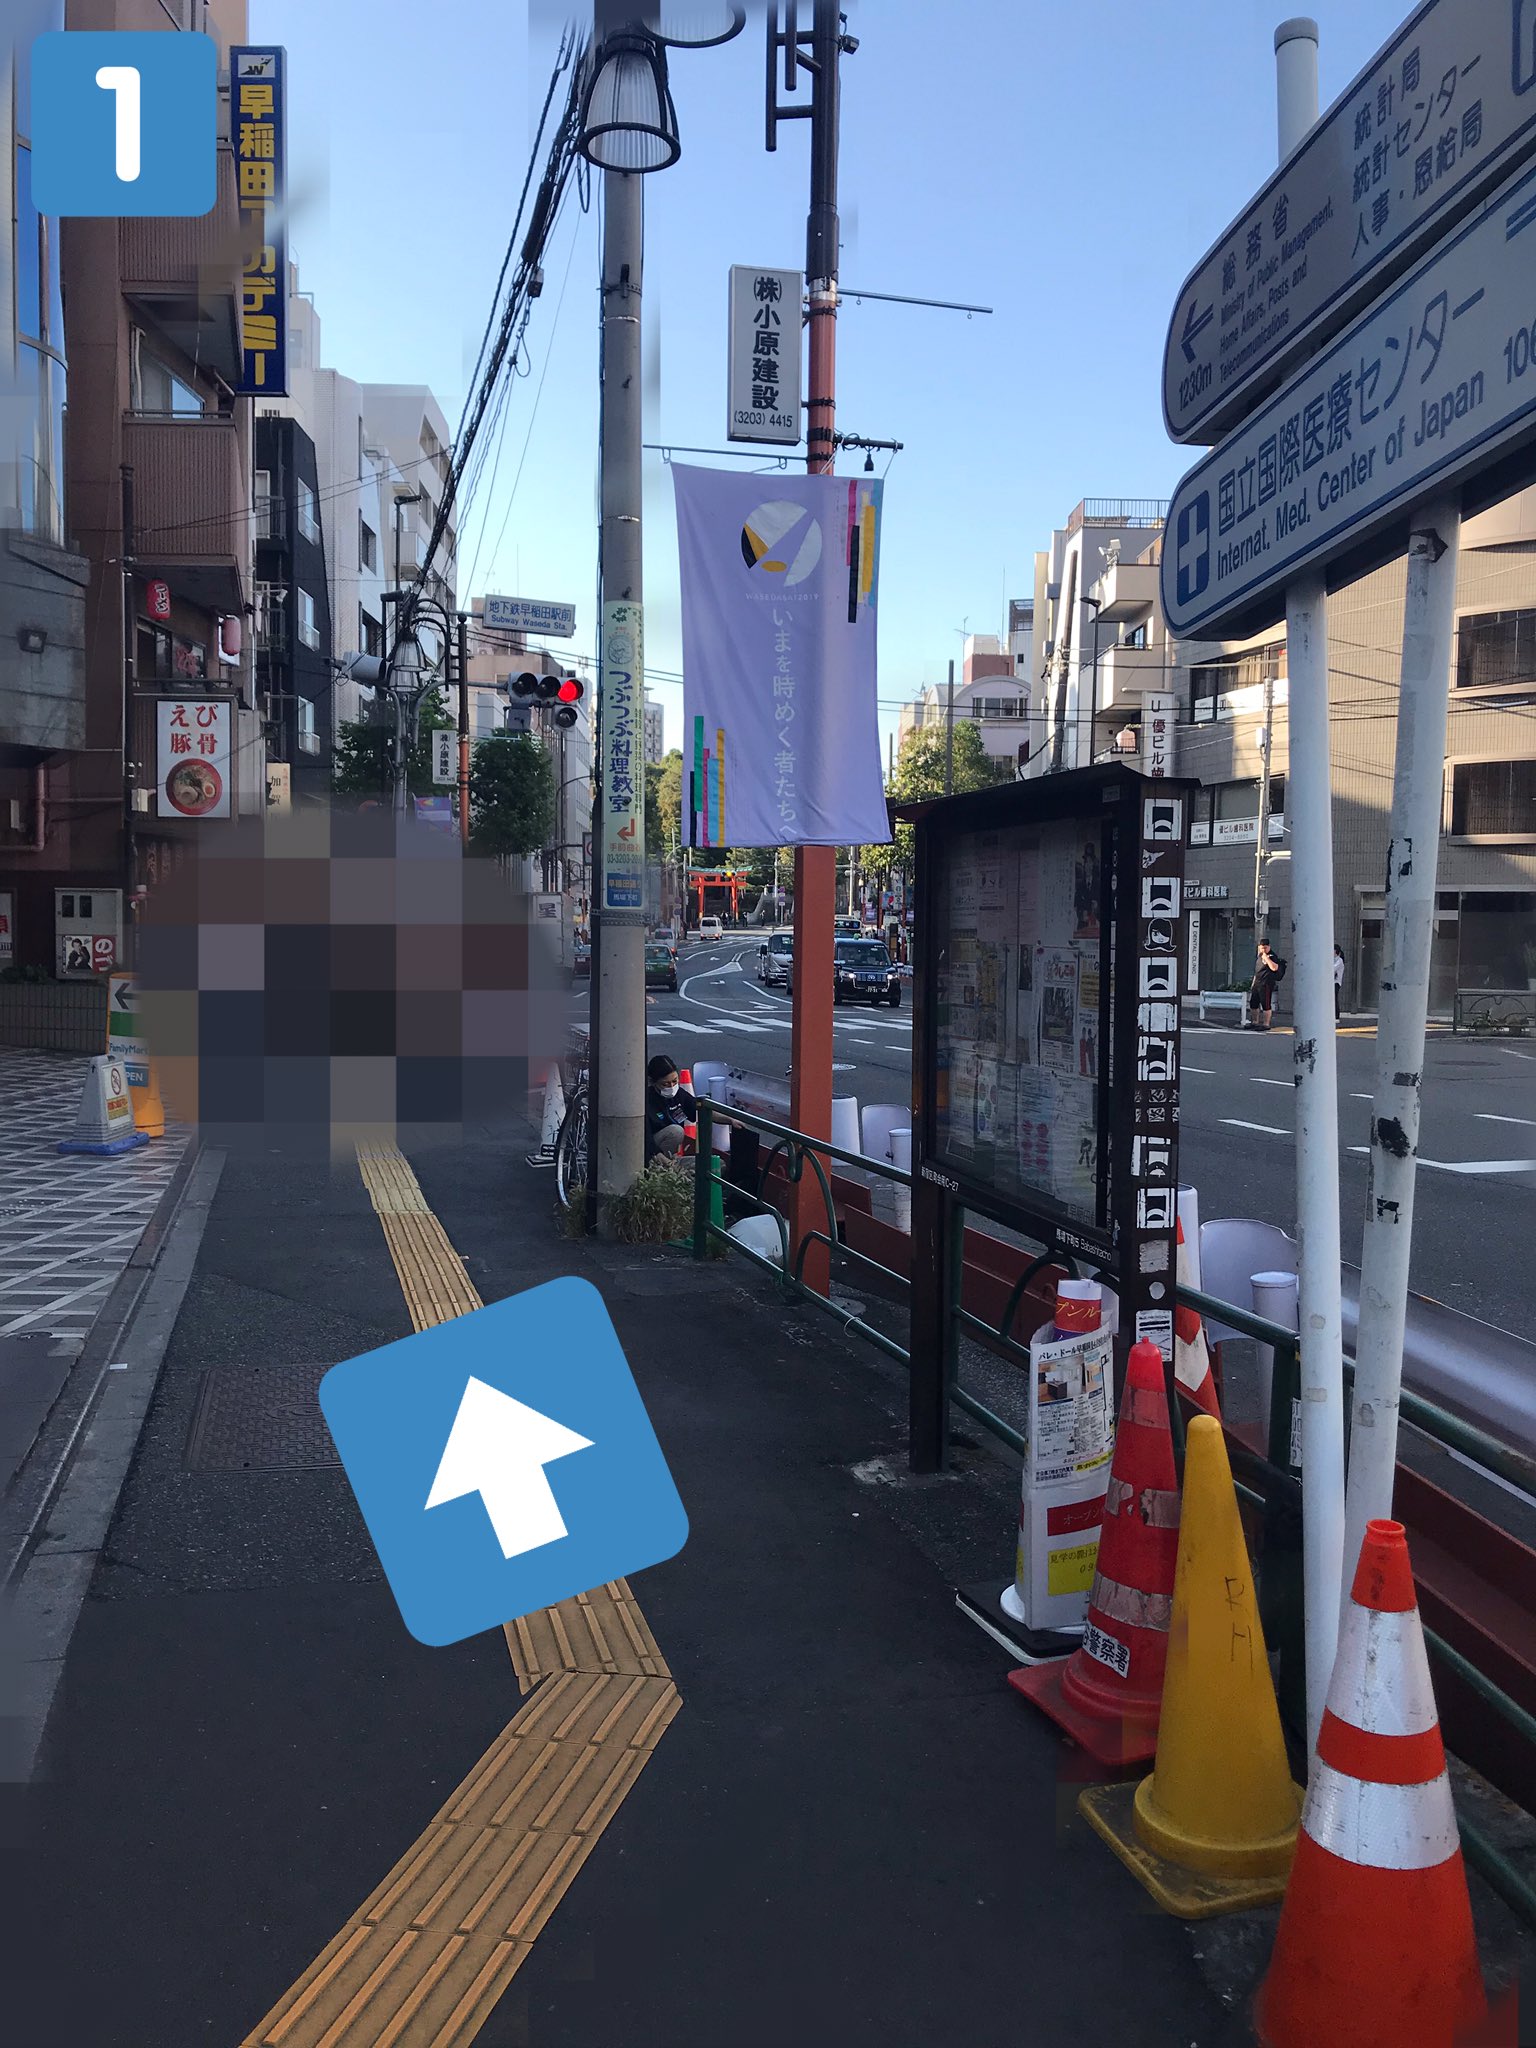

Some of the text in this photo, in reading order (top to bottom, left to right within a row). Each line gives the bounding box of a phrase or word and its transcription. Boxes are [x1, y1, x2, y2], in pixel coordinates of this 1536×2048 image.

[1353, 54, 1482, 204] 統計センター
[1354, 46, 1420, 151] 統計局
[1351, 98, 1482, 259] 人事・恩給局
[1222, 193, 1289, 296] 総務省
[1219, 326, 1239, 355] Home
[1268, 276, 1290, 311] Posts
[1292, 253, 1308, 289] and
[1221, 290, 1245, 327] Ministry
[1247, 277, 1255, 297] of
[1257, 254, 1279, 291] Public
[1178, 361, 1212, 412] 1230m
[1219, 307, 1290, 384] Telecommunications
[733, 411, 793, 429] (3203) 4415
[1218, 287, 1486, 537] 国立国際医療センター
[1217, 517, 1270, 581] Internat.
[1275, 486, 1310, 542] Med.
[1317, 447, 1375, 512] Center
[1385, 415, 1405, 466] of
[1414, 369, 1485, 447] Japan
[489, 600, 572, 622] 地下鉄早稲田駅前
[491, 614, 568, 631] Subway Waseda Sta.
[170, 704, 219, 728] えび
[170, 732, 219, 755] 豚骨
[608, 671, 635, 813] つぶつぶ料理教室
[771, 607, 798, 837] いまを時めく者たちへ
[126, 1072, 143, 1081] PEN
